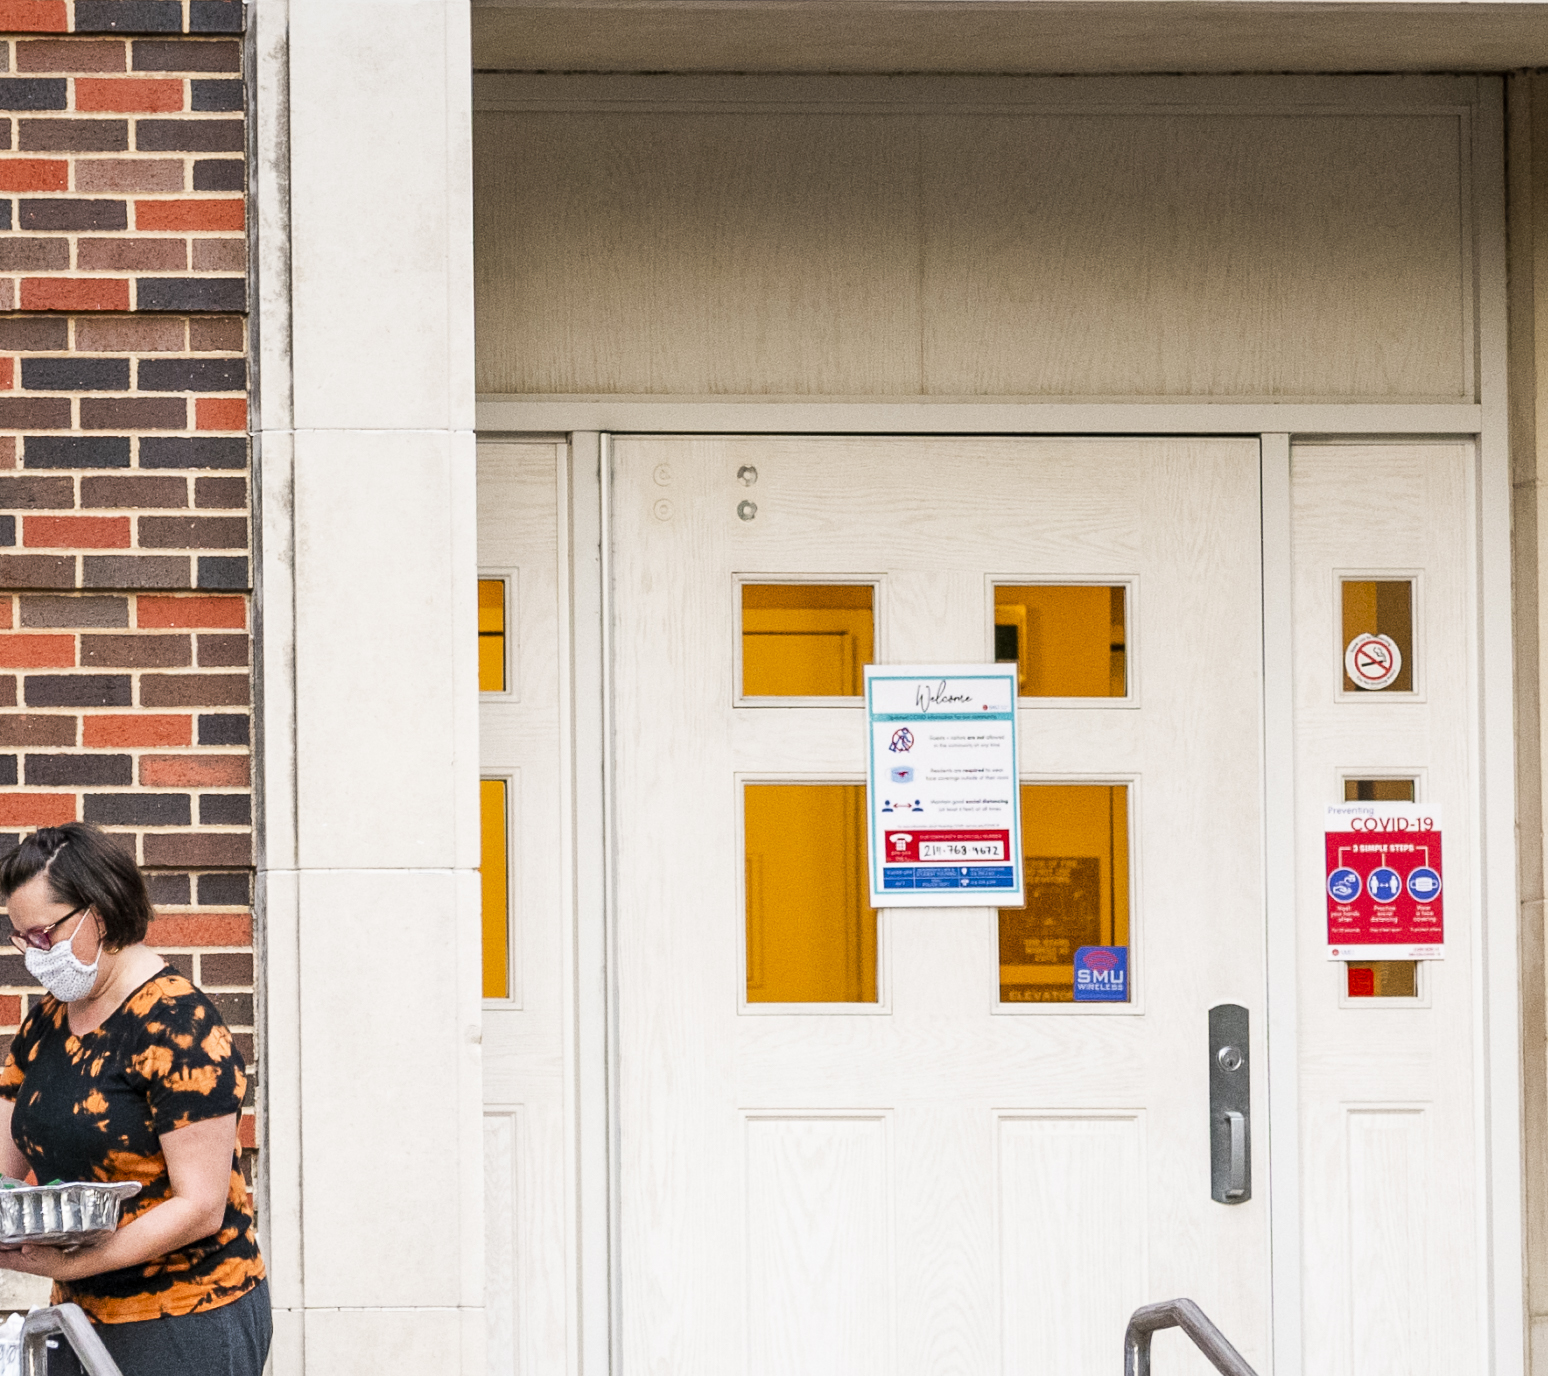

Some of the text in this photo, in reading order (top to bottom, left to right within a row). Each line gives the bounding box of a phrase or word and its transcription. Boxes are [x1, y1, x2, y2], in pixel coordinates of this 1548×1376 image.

[915, 679, 973, 713] Welcome
[1327, 806, 1374, 816] Preventing
[1350, 817, 1434, 832] COVID-19
[1359, 843, 1388, 853] SIMPLE
[1389, 843, 1415, 853] STEPS
[1077, 969, 1124, 984] SMU
[1077, 983, 1124, 991] WIRELESS
